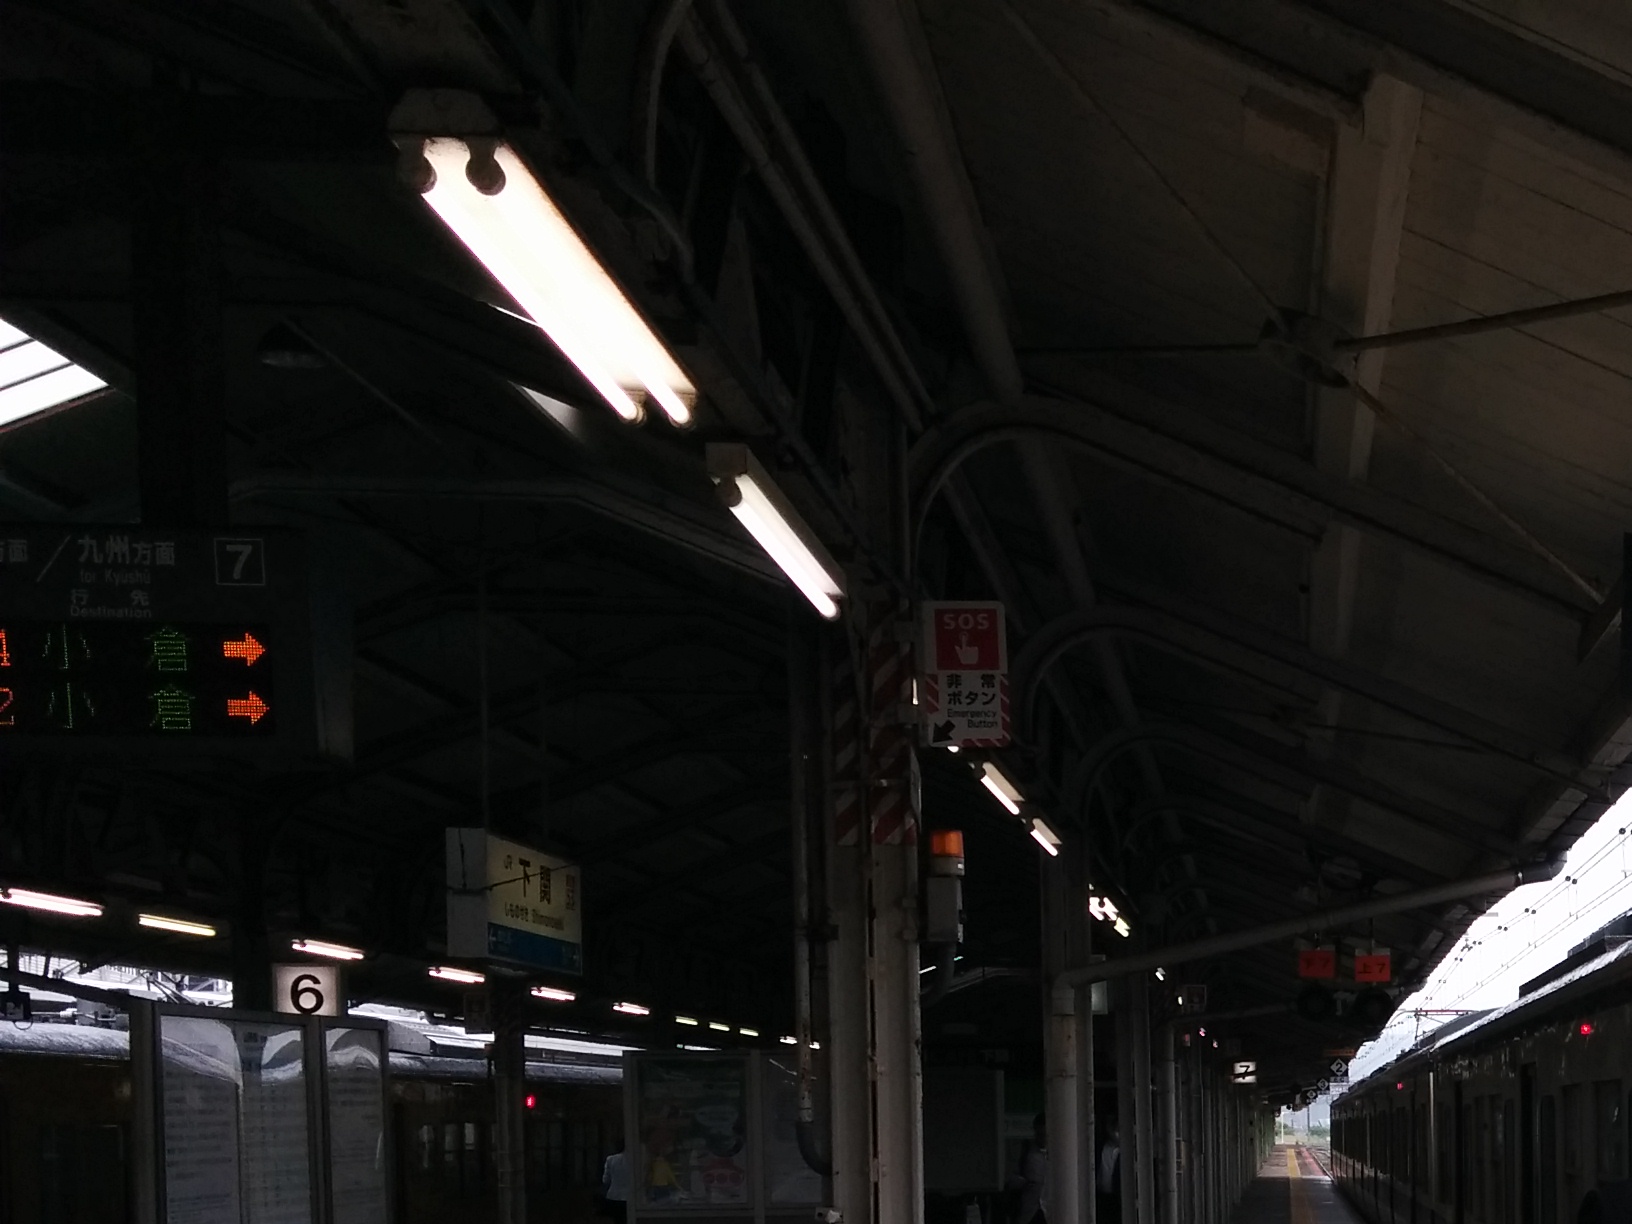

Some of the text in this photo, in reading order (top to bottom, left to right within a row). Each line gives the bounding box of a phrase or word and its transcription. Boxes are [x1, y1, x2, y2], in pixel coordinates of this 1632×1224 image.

[225, 544, 253, 580] 7
[70, 604, 153, 618] Destination
[943, 613, 990, 630] SOS
[947, 674, 996, 689] 非常
[947, 691, 997, 706] ボタン
[947, 708, 997, 720] Emergency
[967, 719, 998, 729] Button
[1358, 962, 1386, 974] 上7
[290, 973, 324, 1015] 6
